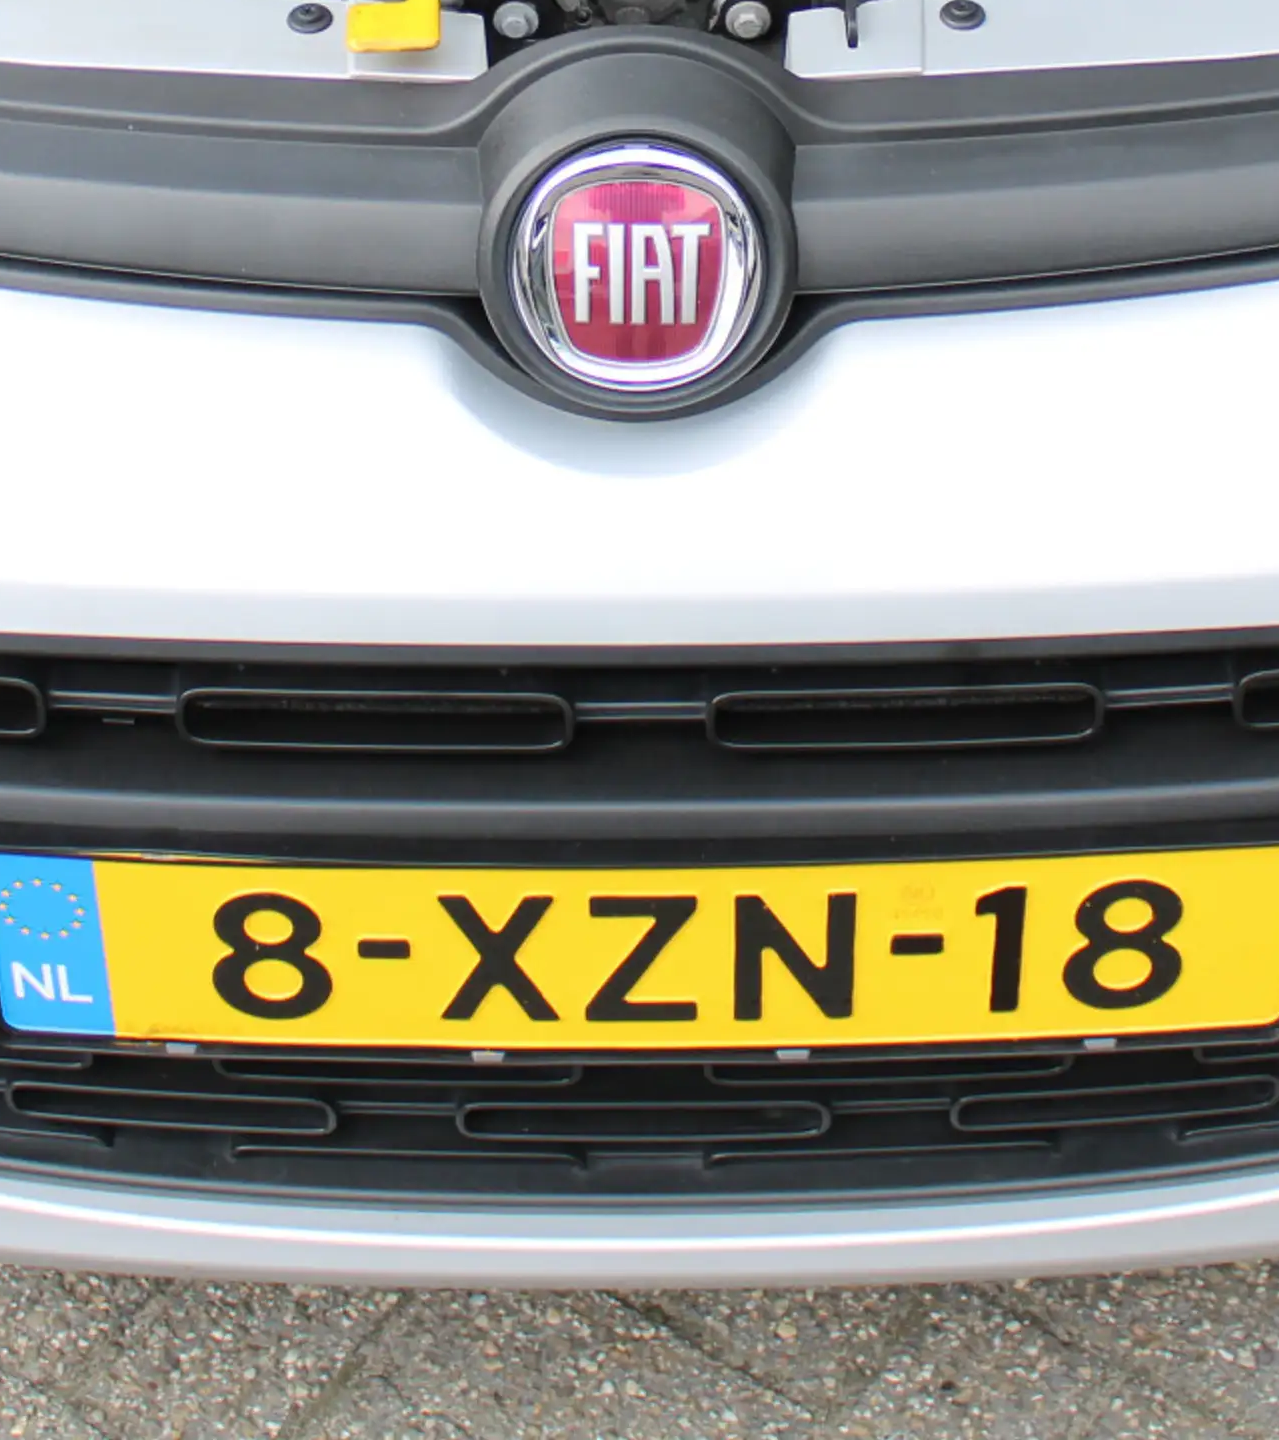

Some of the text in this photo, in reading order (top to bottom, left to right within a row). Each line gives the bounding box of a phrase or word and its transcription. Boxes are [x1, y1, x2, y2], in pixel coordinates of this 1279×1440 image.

[573, 222, 711, 325] FIAT
[11, 961, 94, 1003] NL
[212, 879, 1184, 1021] 8-XZN-18
